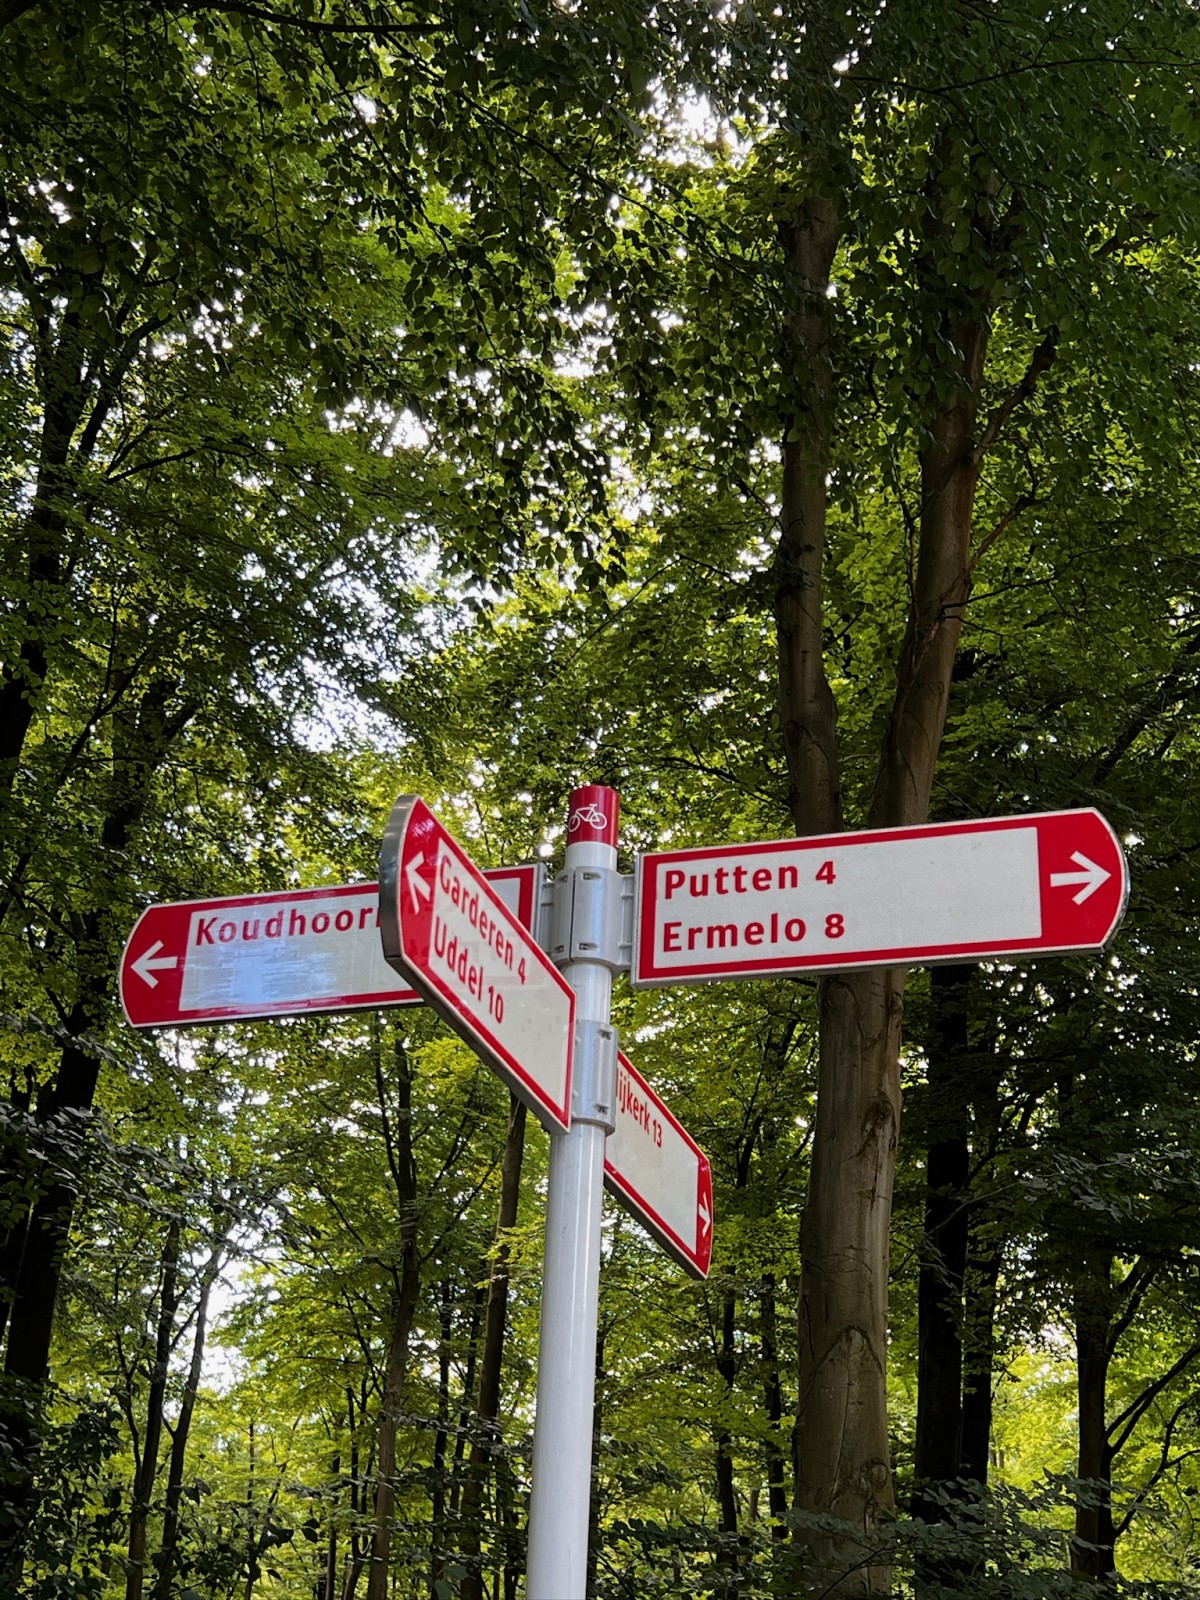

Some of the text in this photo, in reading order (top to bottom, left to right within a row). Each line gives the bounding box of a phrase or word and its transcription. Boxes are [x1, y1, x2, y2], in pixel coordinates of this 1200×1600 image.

[664, 860, 836, 900] Putten 4
[195, 907, 381, 946] Koudhoor
[440, 855, 527, 985] Garderen 4
[663, 912, 845, 952] Ermelo 8
[434, 916, 504, 1024] Uddel 10
[616, 1068, 662, 1148] ijkerk 13
